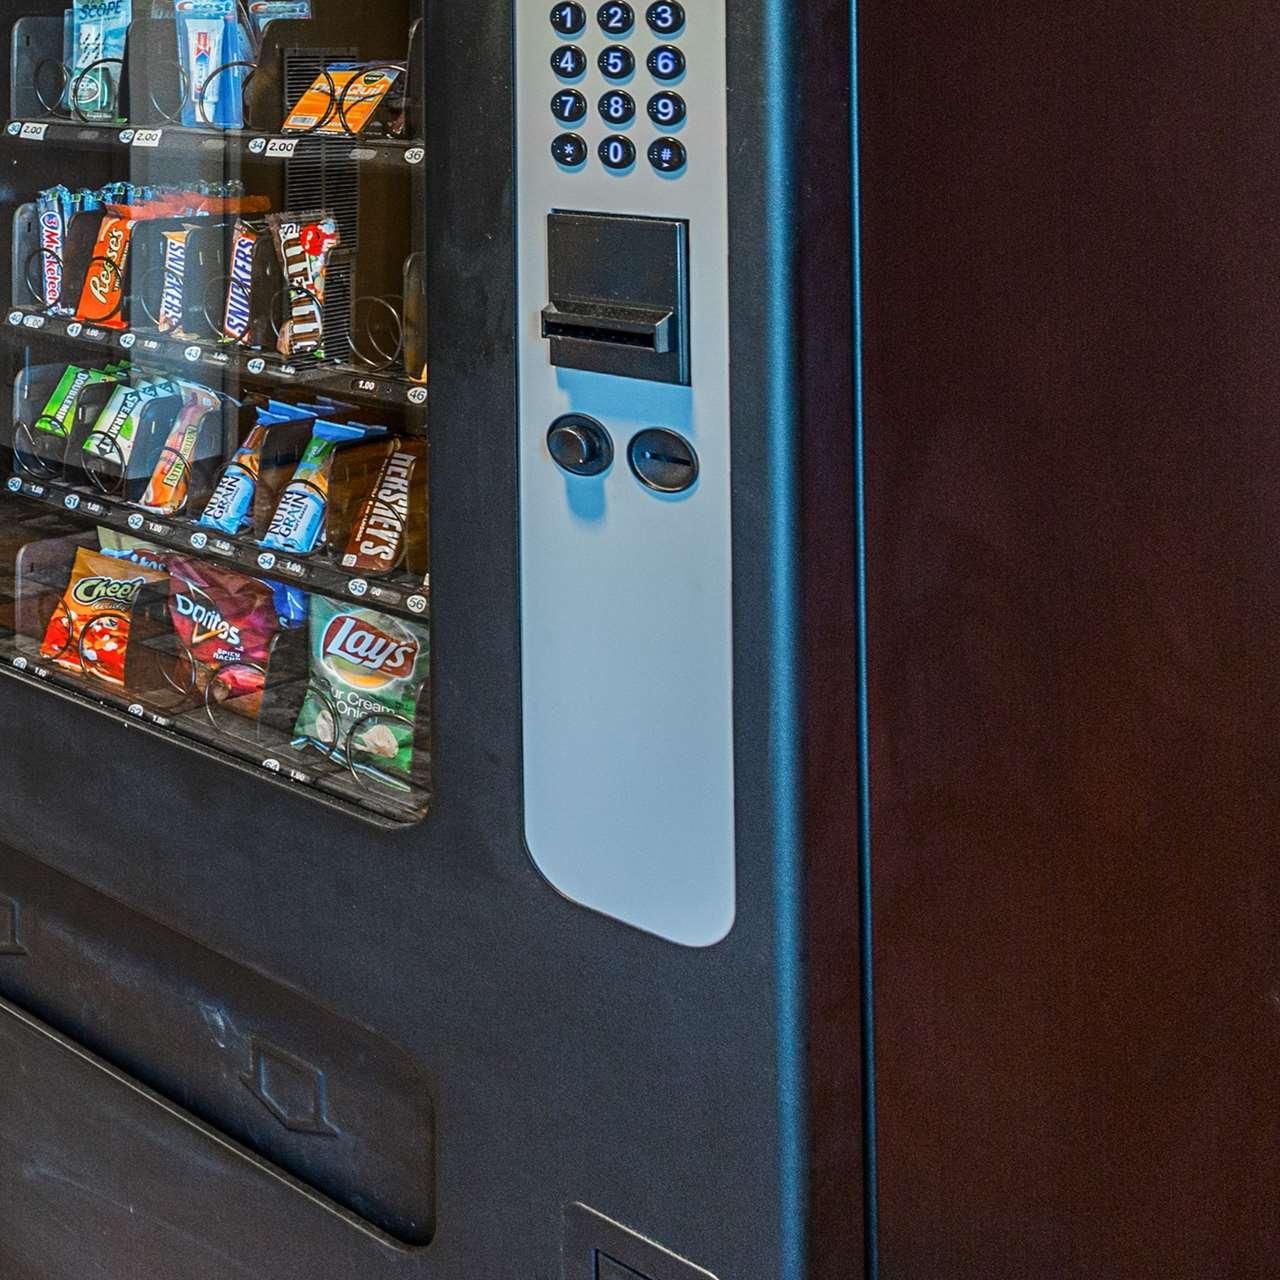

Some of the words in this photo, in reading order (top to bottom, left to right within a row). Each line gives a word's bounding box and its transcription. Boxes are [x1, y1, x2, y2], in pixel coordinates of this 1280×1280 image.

[79, 0, 121, 20] SCOPE
[176, 0, 233, 12] Crest
[561, 6, 571, 28] 1
[608, 6, 623, 28] 2
[655, 5, 673, 28] 3
[559, 51, 574, 72] 4
[607, 52, 622, 73] 5
[657, 52, 674, 74] 6
[560, 96, 574, 117] 7
[609, 96, 624, 118] 8
[657, 98, 674, 120] 9
[23, 126, 42, 134] 2.00
[137, 133, 158, 141] 2.00
[269, 142, 294, 151] 2.00
[608, 141, 622, 163] 0
[87, 502, 100, 512] 1.00
[213, 476, 241, 519] GRAIN
[279, 493, 308, 538] GRAIN
[149, 523, 163, 533] 1.00
[176, 593, 240, 645] Doritos
